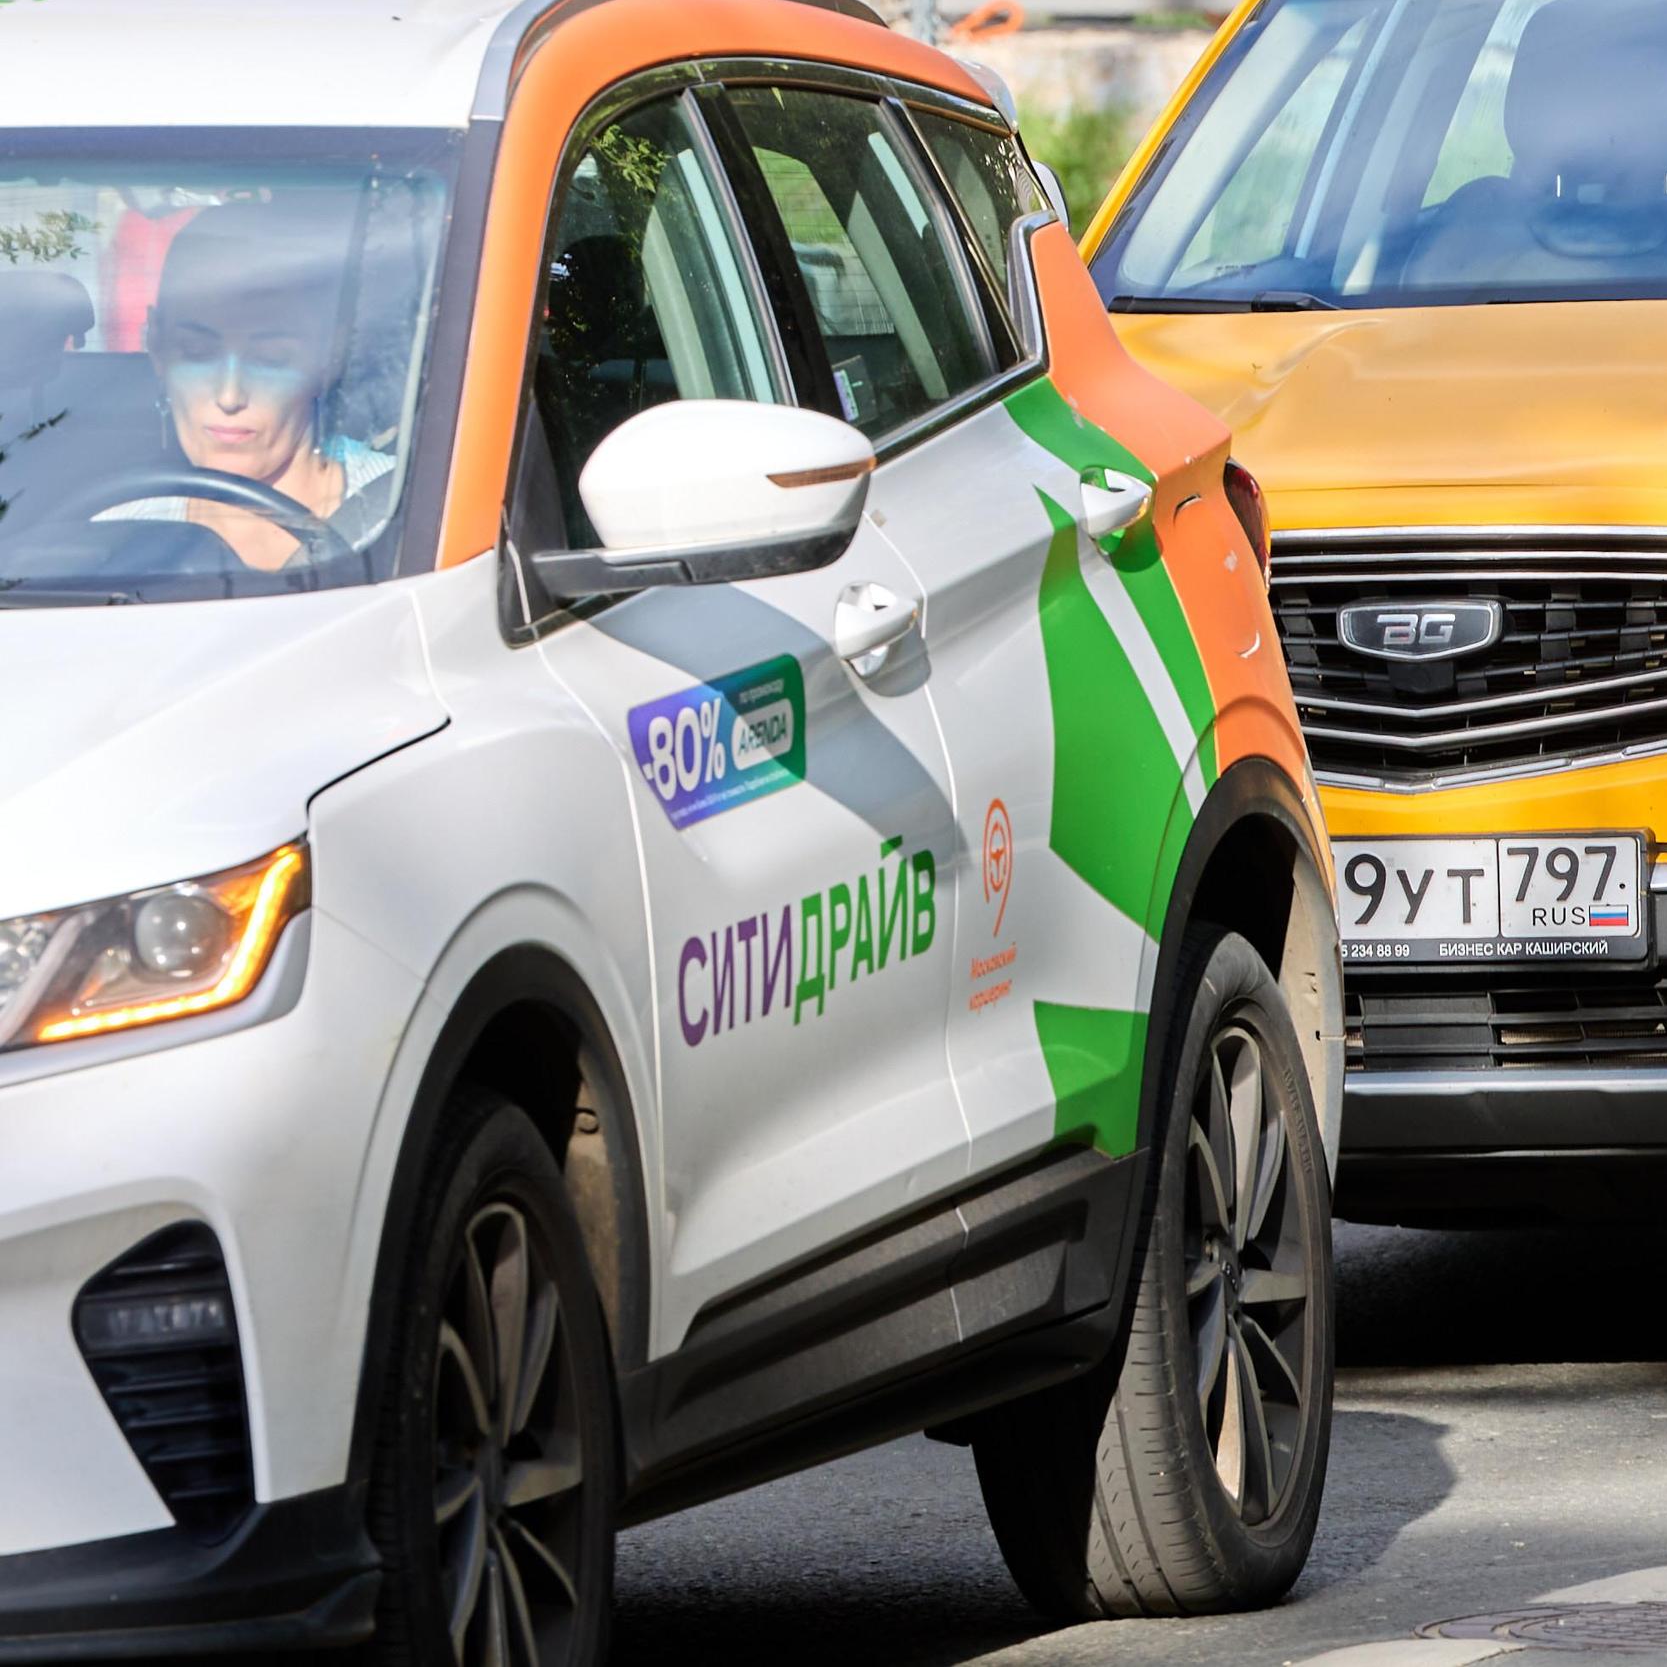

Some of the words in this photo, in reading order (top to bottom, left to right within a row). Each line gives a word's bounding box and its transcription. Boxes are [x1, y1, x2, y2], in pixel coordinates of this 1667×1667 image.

[642, 697, 726, 801] -80%
[1506, 846, 1618, 902] 797
[1531, 906, 1586, 926] RUS
[678, 834, 936, 1048] СИТИДРАЙВ
[1351, 944, 1373, 958] 234
[1376, 944, 1392, 957] 88
[1394, 943, 1410, 957] 99
[1439, 942, 1494, 956] БИЗНЕС
[1497, 942, 1523, 956] КАР
[1525, 940, 1609, 955] КАШИРСКИЙ
